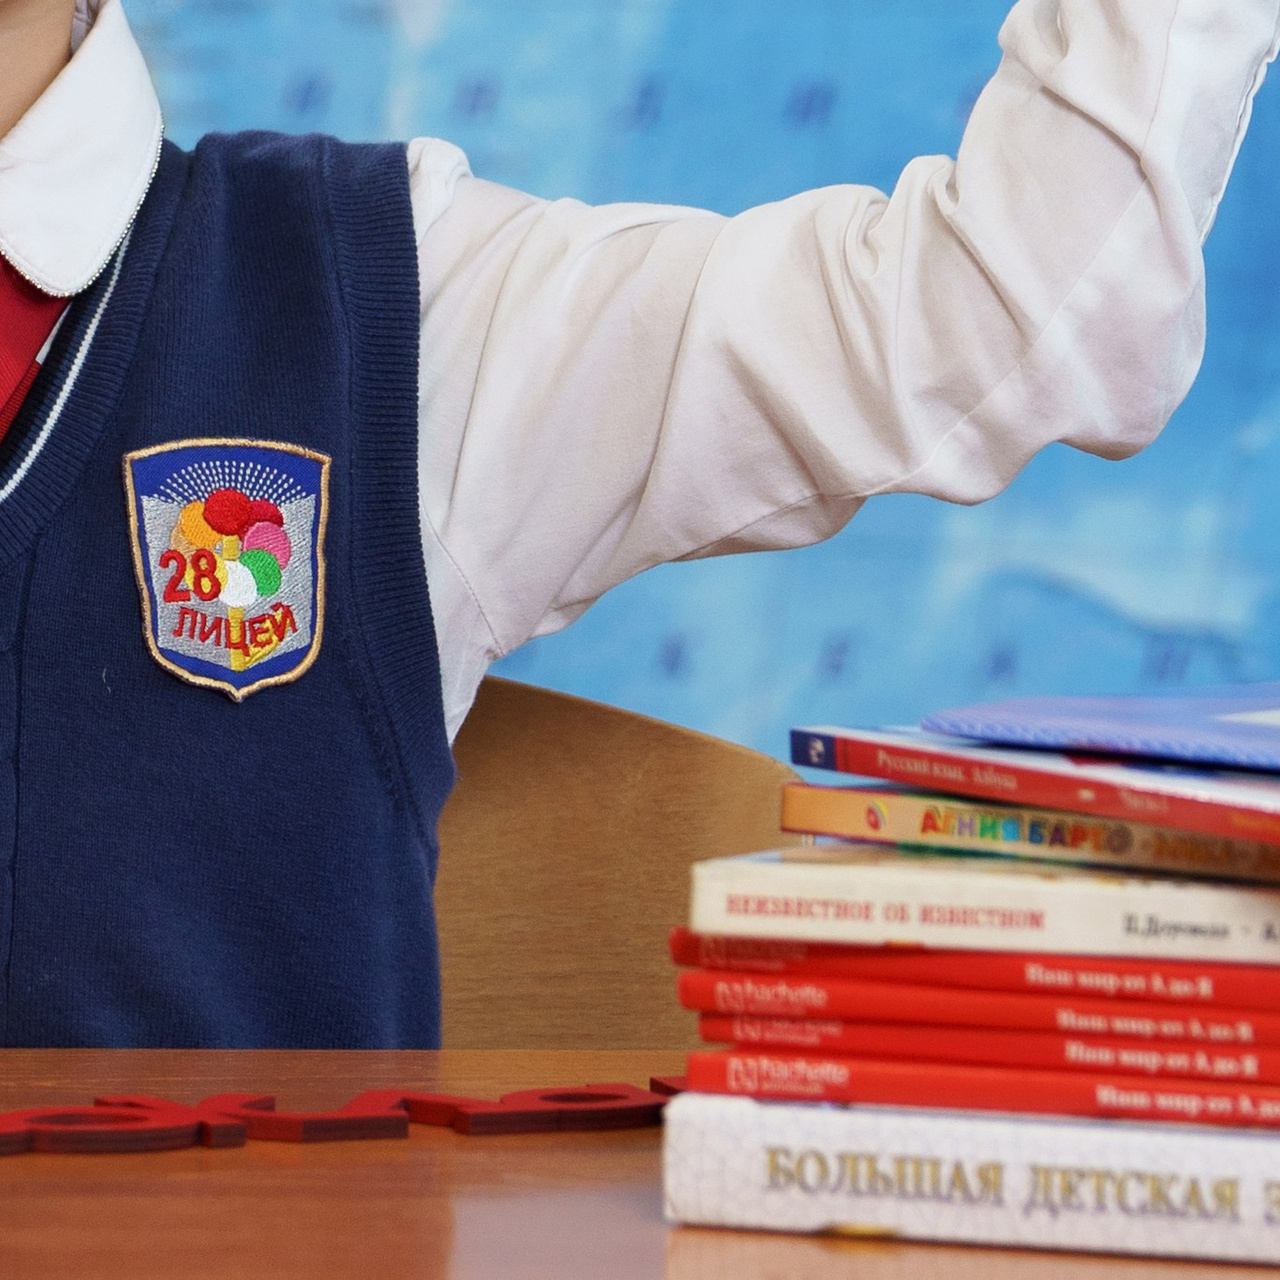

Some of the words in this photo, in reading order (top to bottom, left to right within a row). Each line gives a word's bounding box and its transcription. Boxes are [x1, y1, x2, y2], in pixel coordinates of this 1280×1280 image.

[158, 548, 221, 603] 28
[172, 601, 299, 657] ЛИЦЕЙ
[920, 804, 1020, 843] АГНИЯ
[1027, 819, 1133, 856] БАРТО
[726, 894, 875, 921] НЕИЗВЕСТНОЕ
[883, 901, 911, 925] ОБ
[920, 903, 1046, 930] ИЗВЕСТНОМ
[1024, 963, 1074, 987] Наш
[1055, 1008, 1108, 1032] Наш
[1064, 1040, 1116, 1066] Наш
[1095, 1083, 1152, 1109] Наш
[762, 1145, 1006, 1208] БОЛЬШАЯ
[1022, 1161, 1243, 1222] ДЕТСКАЯ
